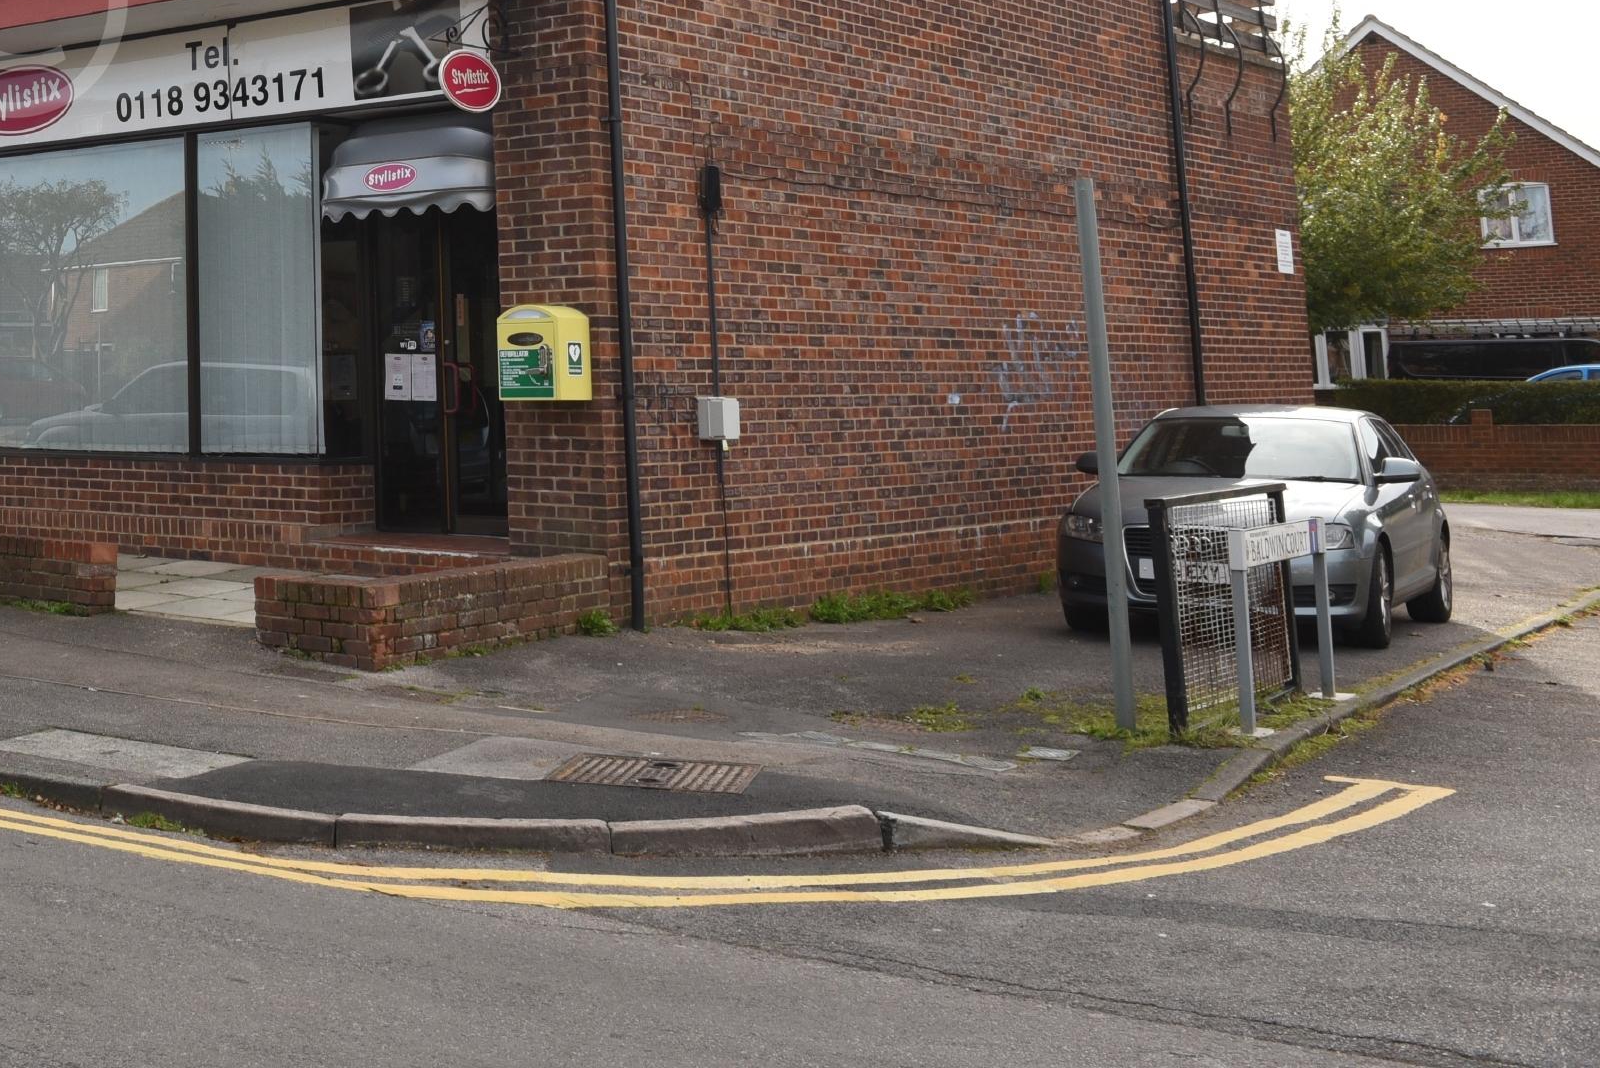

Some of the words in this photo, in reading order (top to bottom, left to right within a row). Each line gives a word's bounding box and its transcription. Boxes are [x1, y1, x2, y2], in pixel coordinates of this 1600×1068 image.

[185, 37, 239, 71] Tel.
[451, 68, 490, 87] Stylistix
[116, 85, 184, 123] 0118
[193, 67, 325, 113] 9343171
[368, 168, 411, 185] Stylistix
[1251, 533, 1285, 562] BALDWIN
[1285, 531, 1308, 554] COURT
